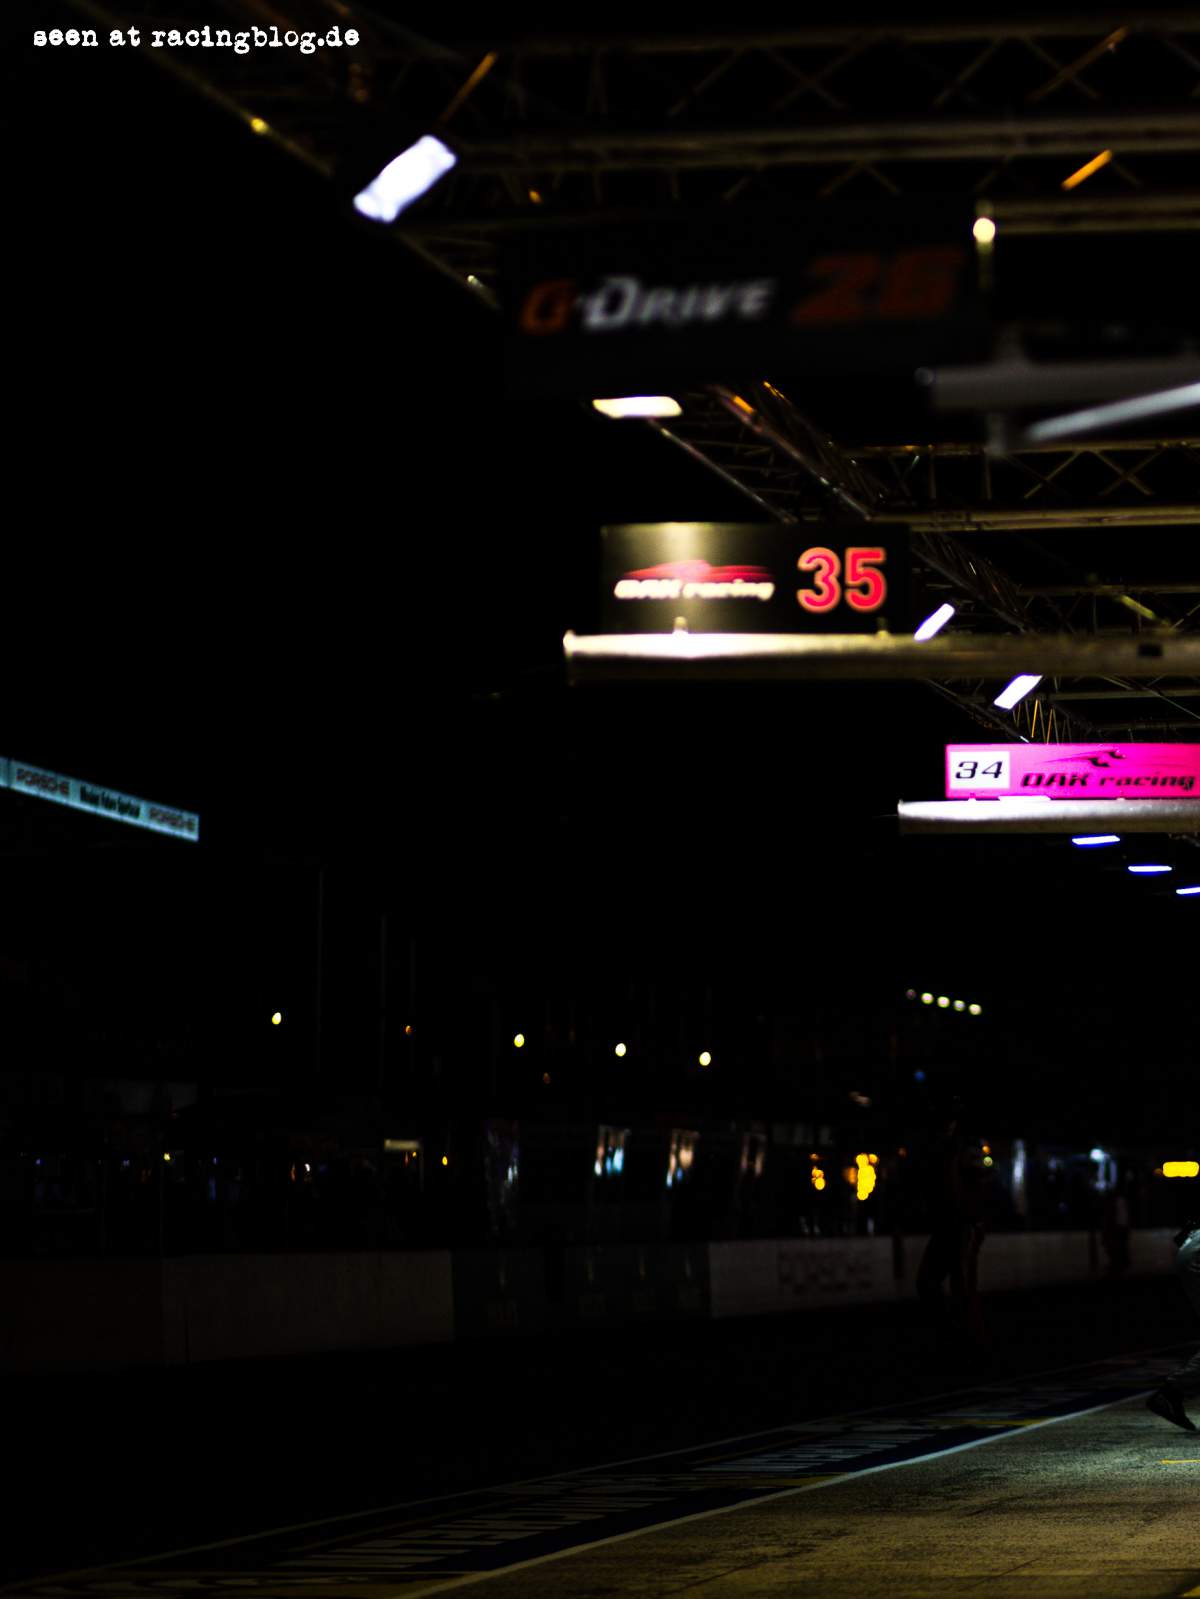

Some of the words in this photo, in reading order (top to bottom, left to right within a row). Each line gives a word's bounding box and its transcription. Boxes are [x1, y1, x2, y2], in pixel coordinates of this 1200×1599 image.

[797, 547, 887, 613] 35
[955, 761, 1003, 779] 34
[1020, 772, 1089, 787] OAK
[1099, 771, 1195, 791] racing
